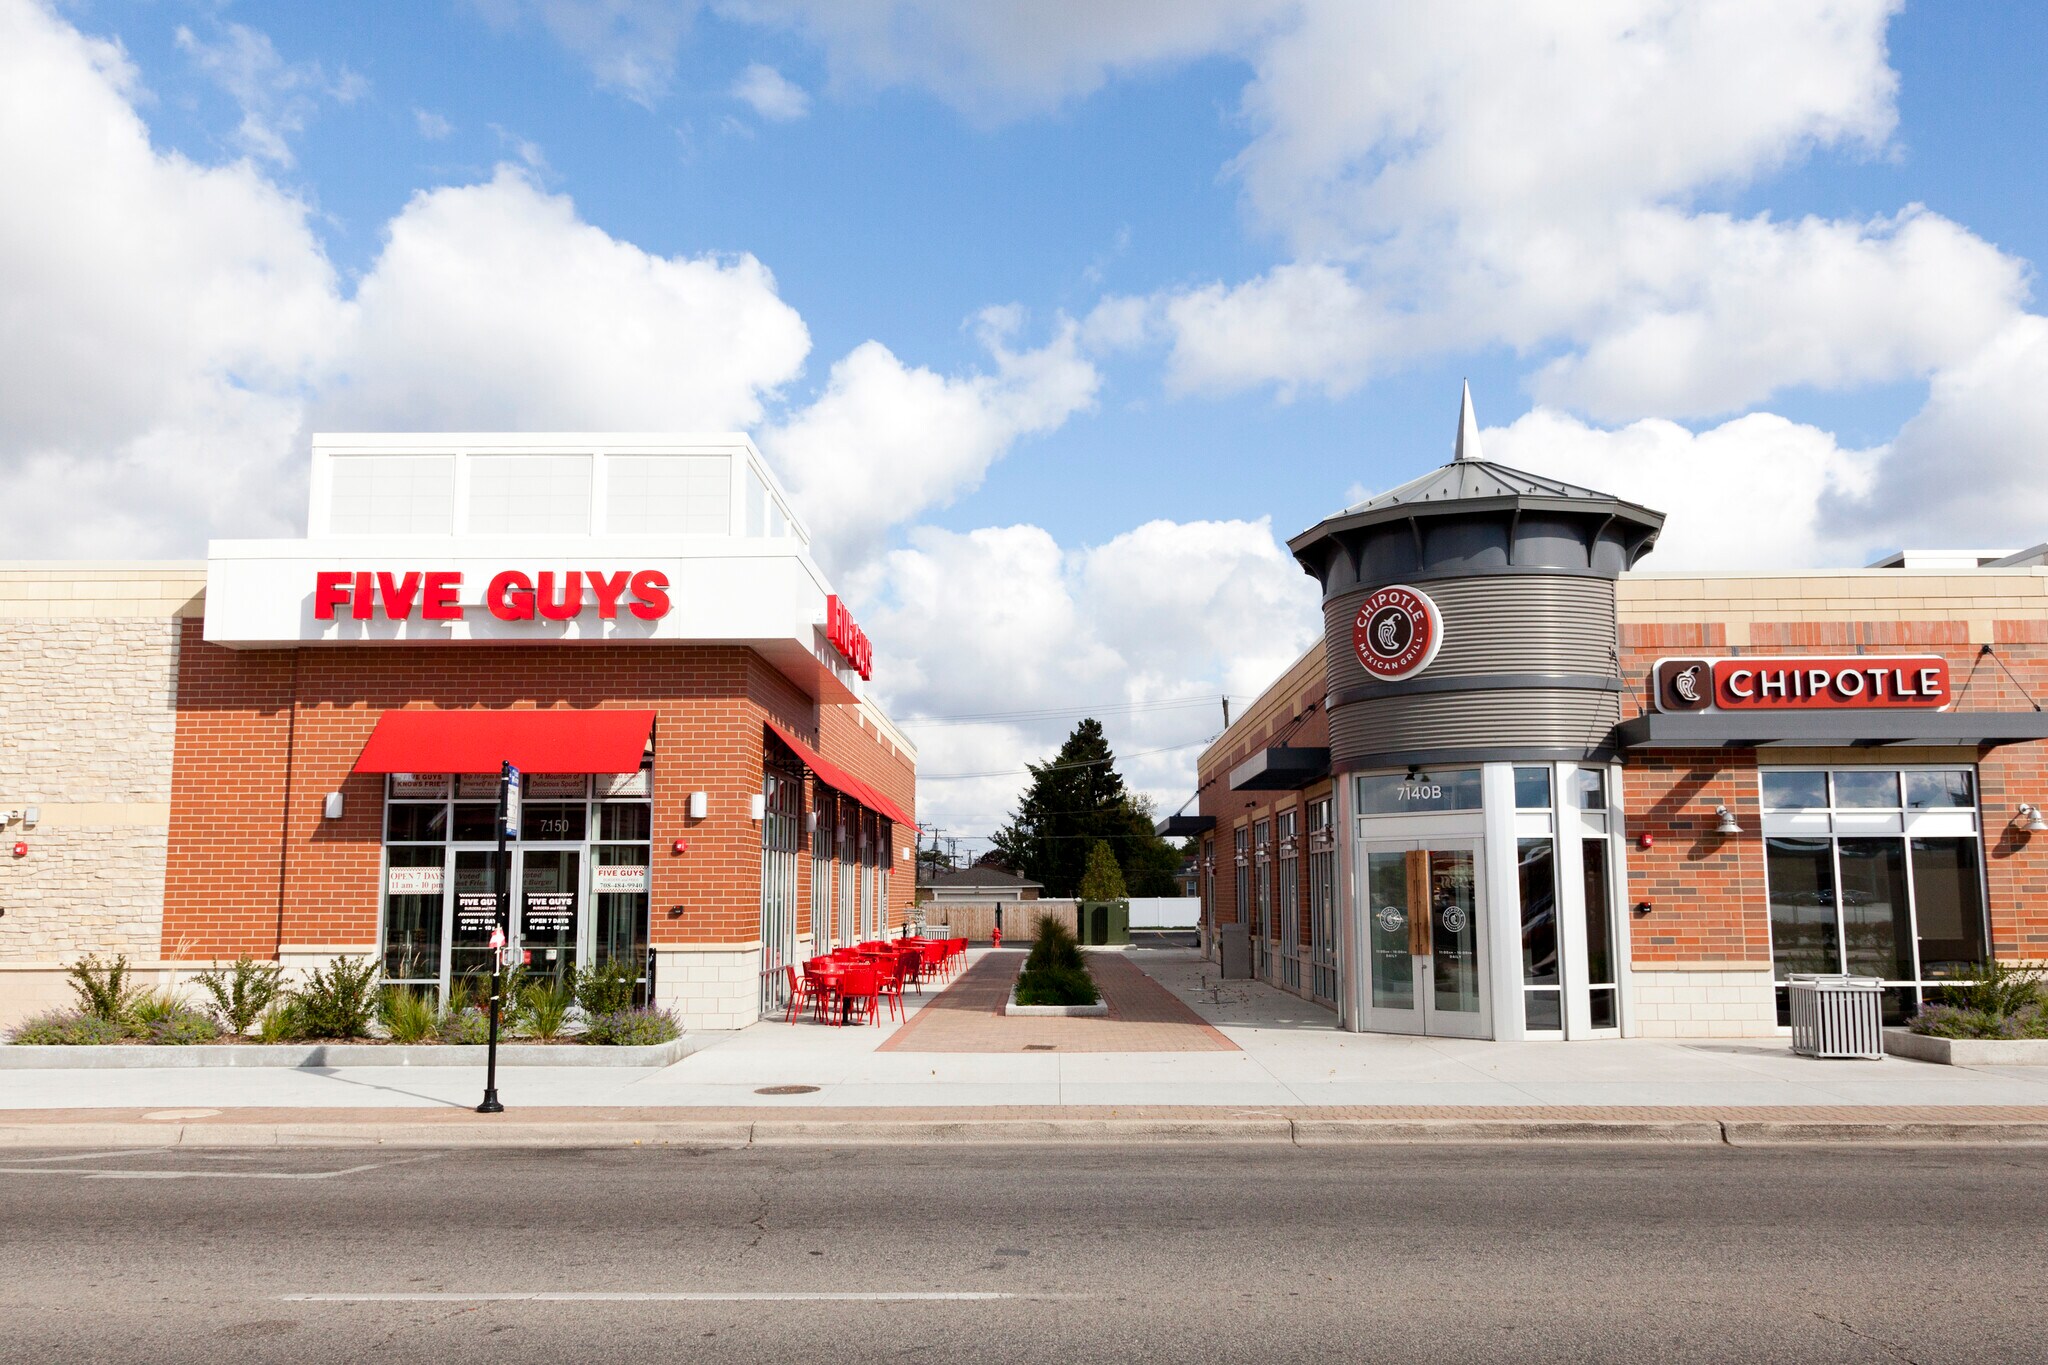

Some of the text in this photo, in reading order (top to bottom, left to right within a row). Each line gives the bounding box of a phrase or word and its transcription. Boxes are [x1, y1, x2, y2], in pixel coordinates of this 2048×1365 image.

[315, 570, 670, 621] FIVE GUYS
[1357, 592, 1424, 627] CHIPOTLE
[1359, 637, 1423, 669] MEXICAN GRILL
[1729, 668, 1943, 697] CHIPOTLE
[1397, 785, 1442, 801] 7140B
[540, 819, 569, 832] 7150
[390, 872, 444, 880] OPEN 7 DAYS
[460, 898, 479, 906] FIVE
